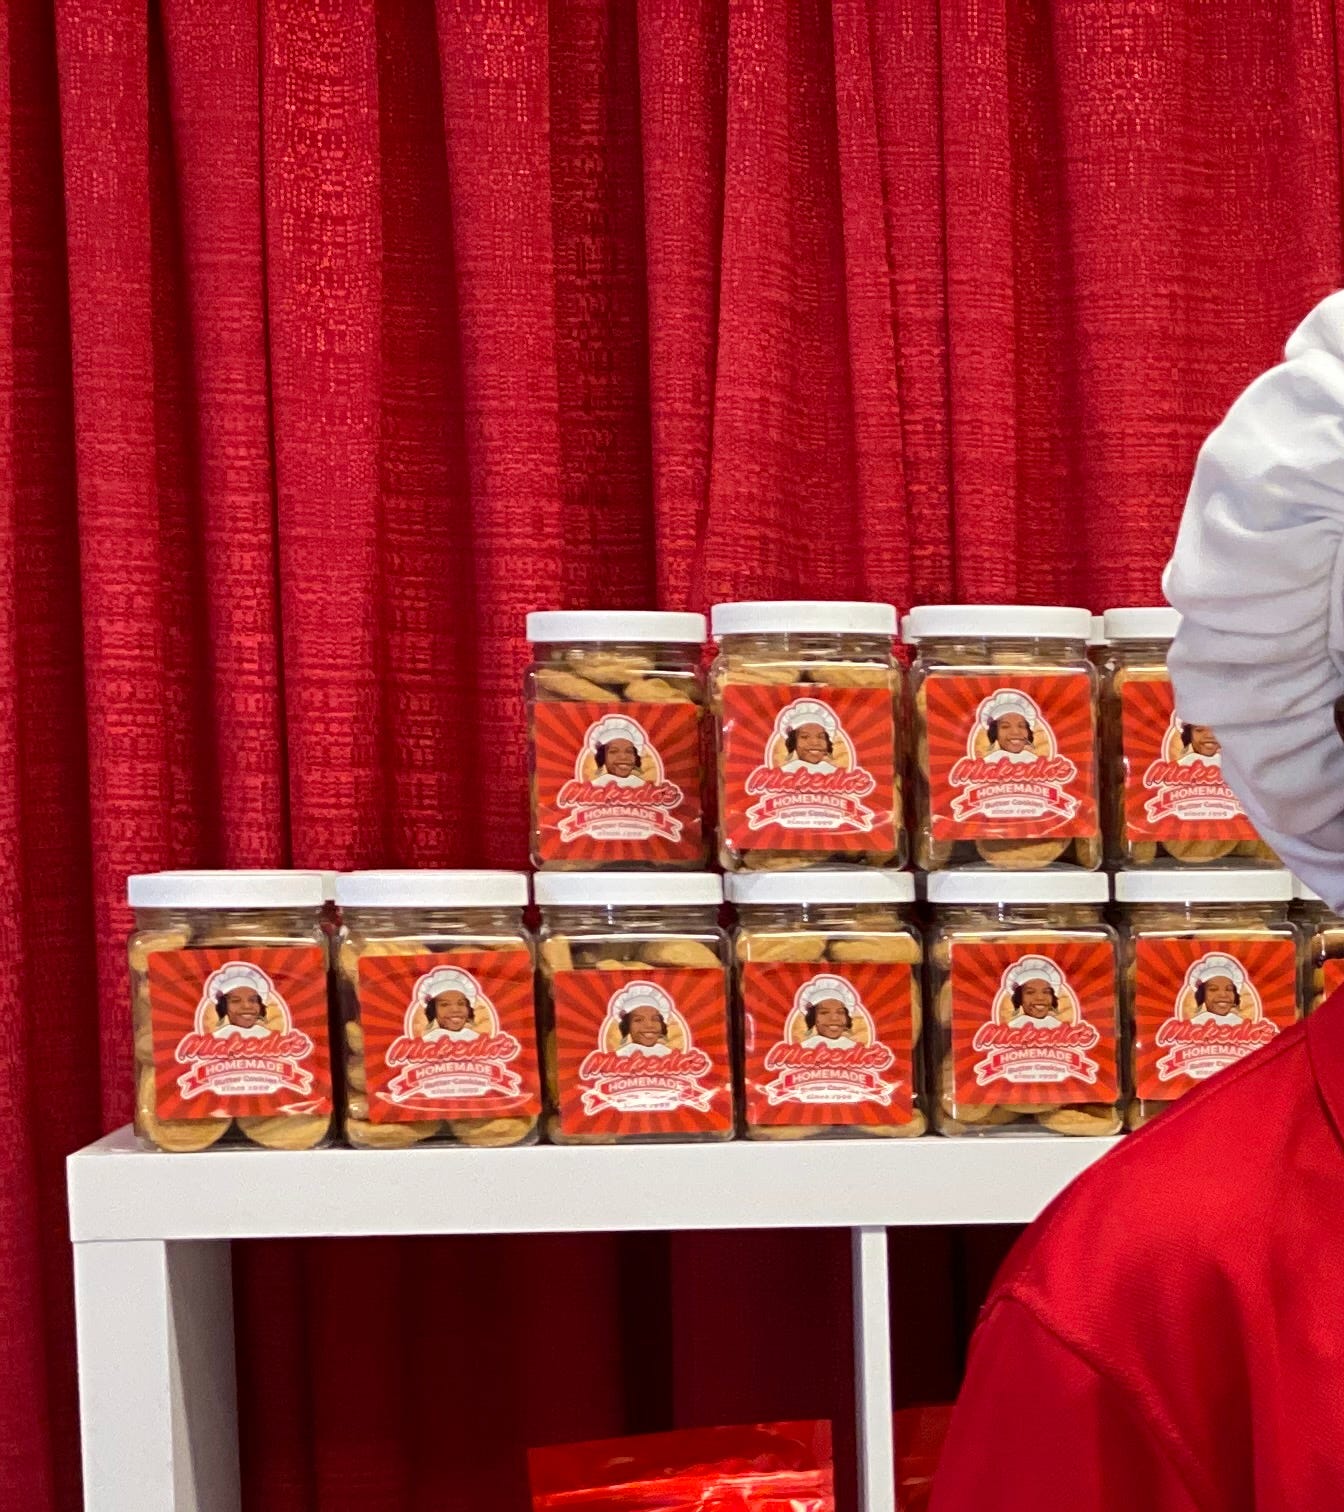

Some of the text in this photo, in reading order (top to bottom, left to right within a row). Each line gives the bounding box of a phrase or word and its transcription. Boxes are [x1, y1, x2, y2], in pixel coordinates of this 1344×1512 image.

[748, 766, 871, 794] Makeda's
[952, 756, 1073, 783] Makeda's
[1146, 758, 1222, 786] Make
[558, 780, 679, 807] Makeda's
[773, 794, 848, 810] HOMEMADE
[976, 783, 1050, 799] HOMEMADE
[1170, 785, 1236, 801] HOMEMAD
[584, 806, 657, 822] HOMEMADE
[178, 1031, 309, 1061] Makeda's
[974, 1021, 1097, 1048] Makeda's
[1158, 1018, 1276, 1047] Makeda's
[389, 1033, 518, 1064] Makeda's
[766, 1040, 891, 1070] Makeda's
[1000, 1048, 1074, 1063] HOMEMADE
[1182, 1044, 1248, 1060] HOMEMAD
[204, 1060, 285, 1076] HOMEMADE
[415, 1061, 493, 1080] HOMEMADE
[582, 1049, 707, 1077] Makeda's
[792, 1069, 867, 1084] HOMEMADE
